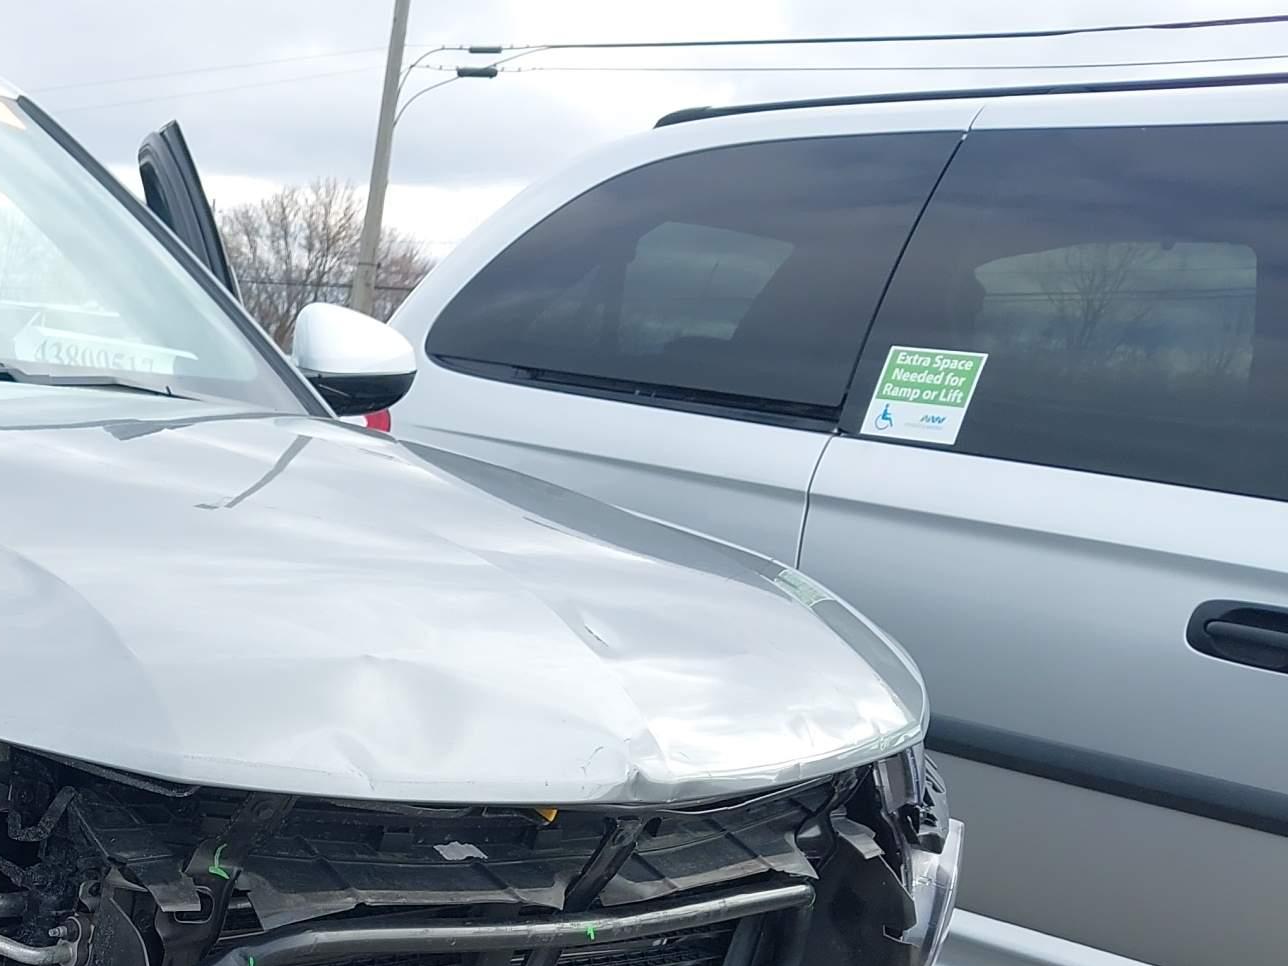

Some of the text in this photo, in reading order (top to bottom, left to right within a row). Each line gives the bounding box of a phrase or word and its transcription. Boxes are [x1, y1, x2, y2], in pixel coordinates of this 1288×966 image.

[897, 352, 973, 371] Extra Space
[892, 369, 966, 387] Needed for
[883, 384, 964, 403] Ramp or Lift
